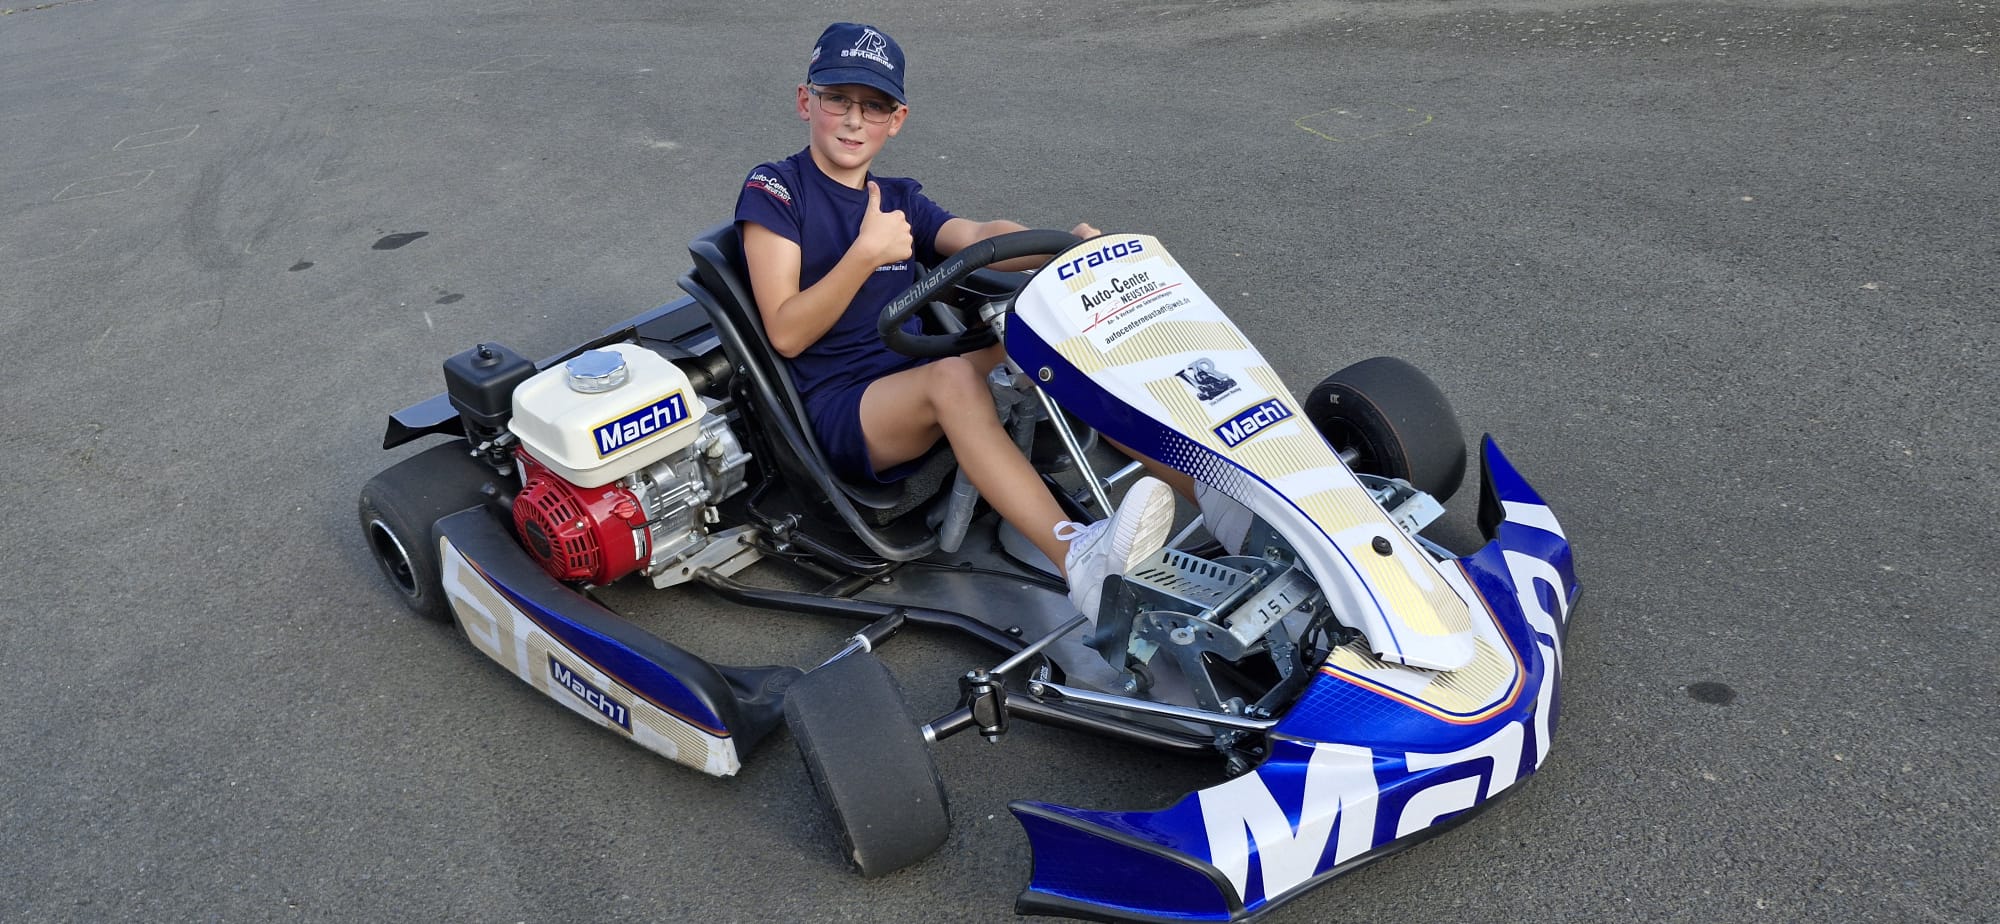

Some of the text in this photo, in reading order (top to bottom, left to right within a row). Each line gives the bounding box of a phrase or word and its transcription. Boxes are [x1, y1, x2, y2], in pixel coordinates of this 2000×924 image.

[1057, 239, 1143, 280] cratos
[1080, 271, 1150, 312] Auto-Center
[1120, 281, 1158, 304] NEUSTADT
[600, 396, 681, 452] Mach1
[1219, 400, 1288, 446] Mach1
[553, 661, 625, 725] Mach1
